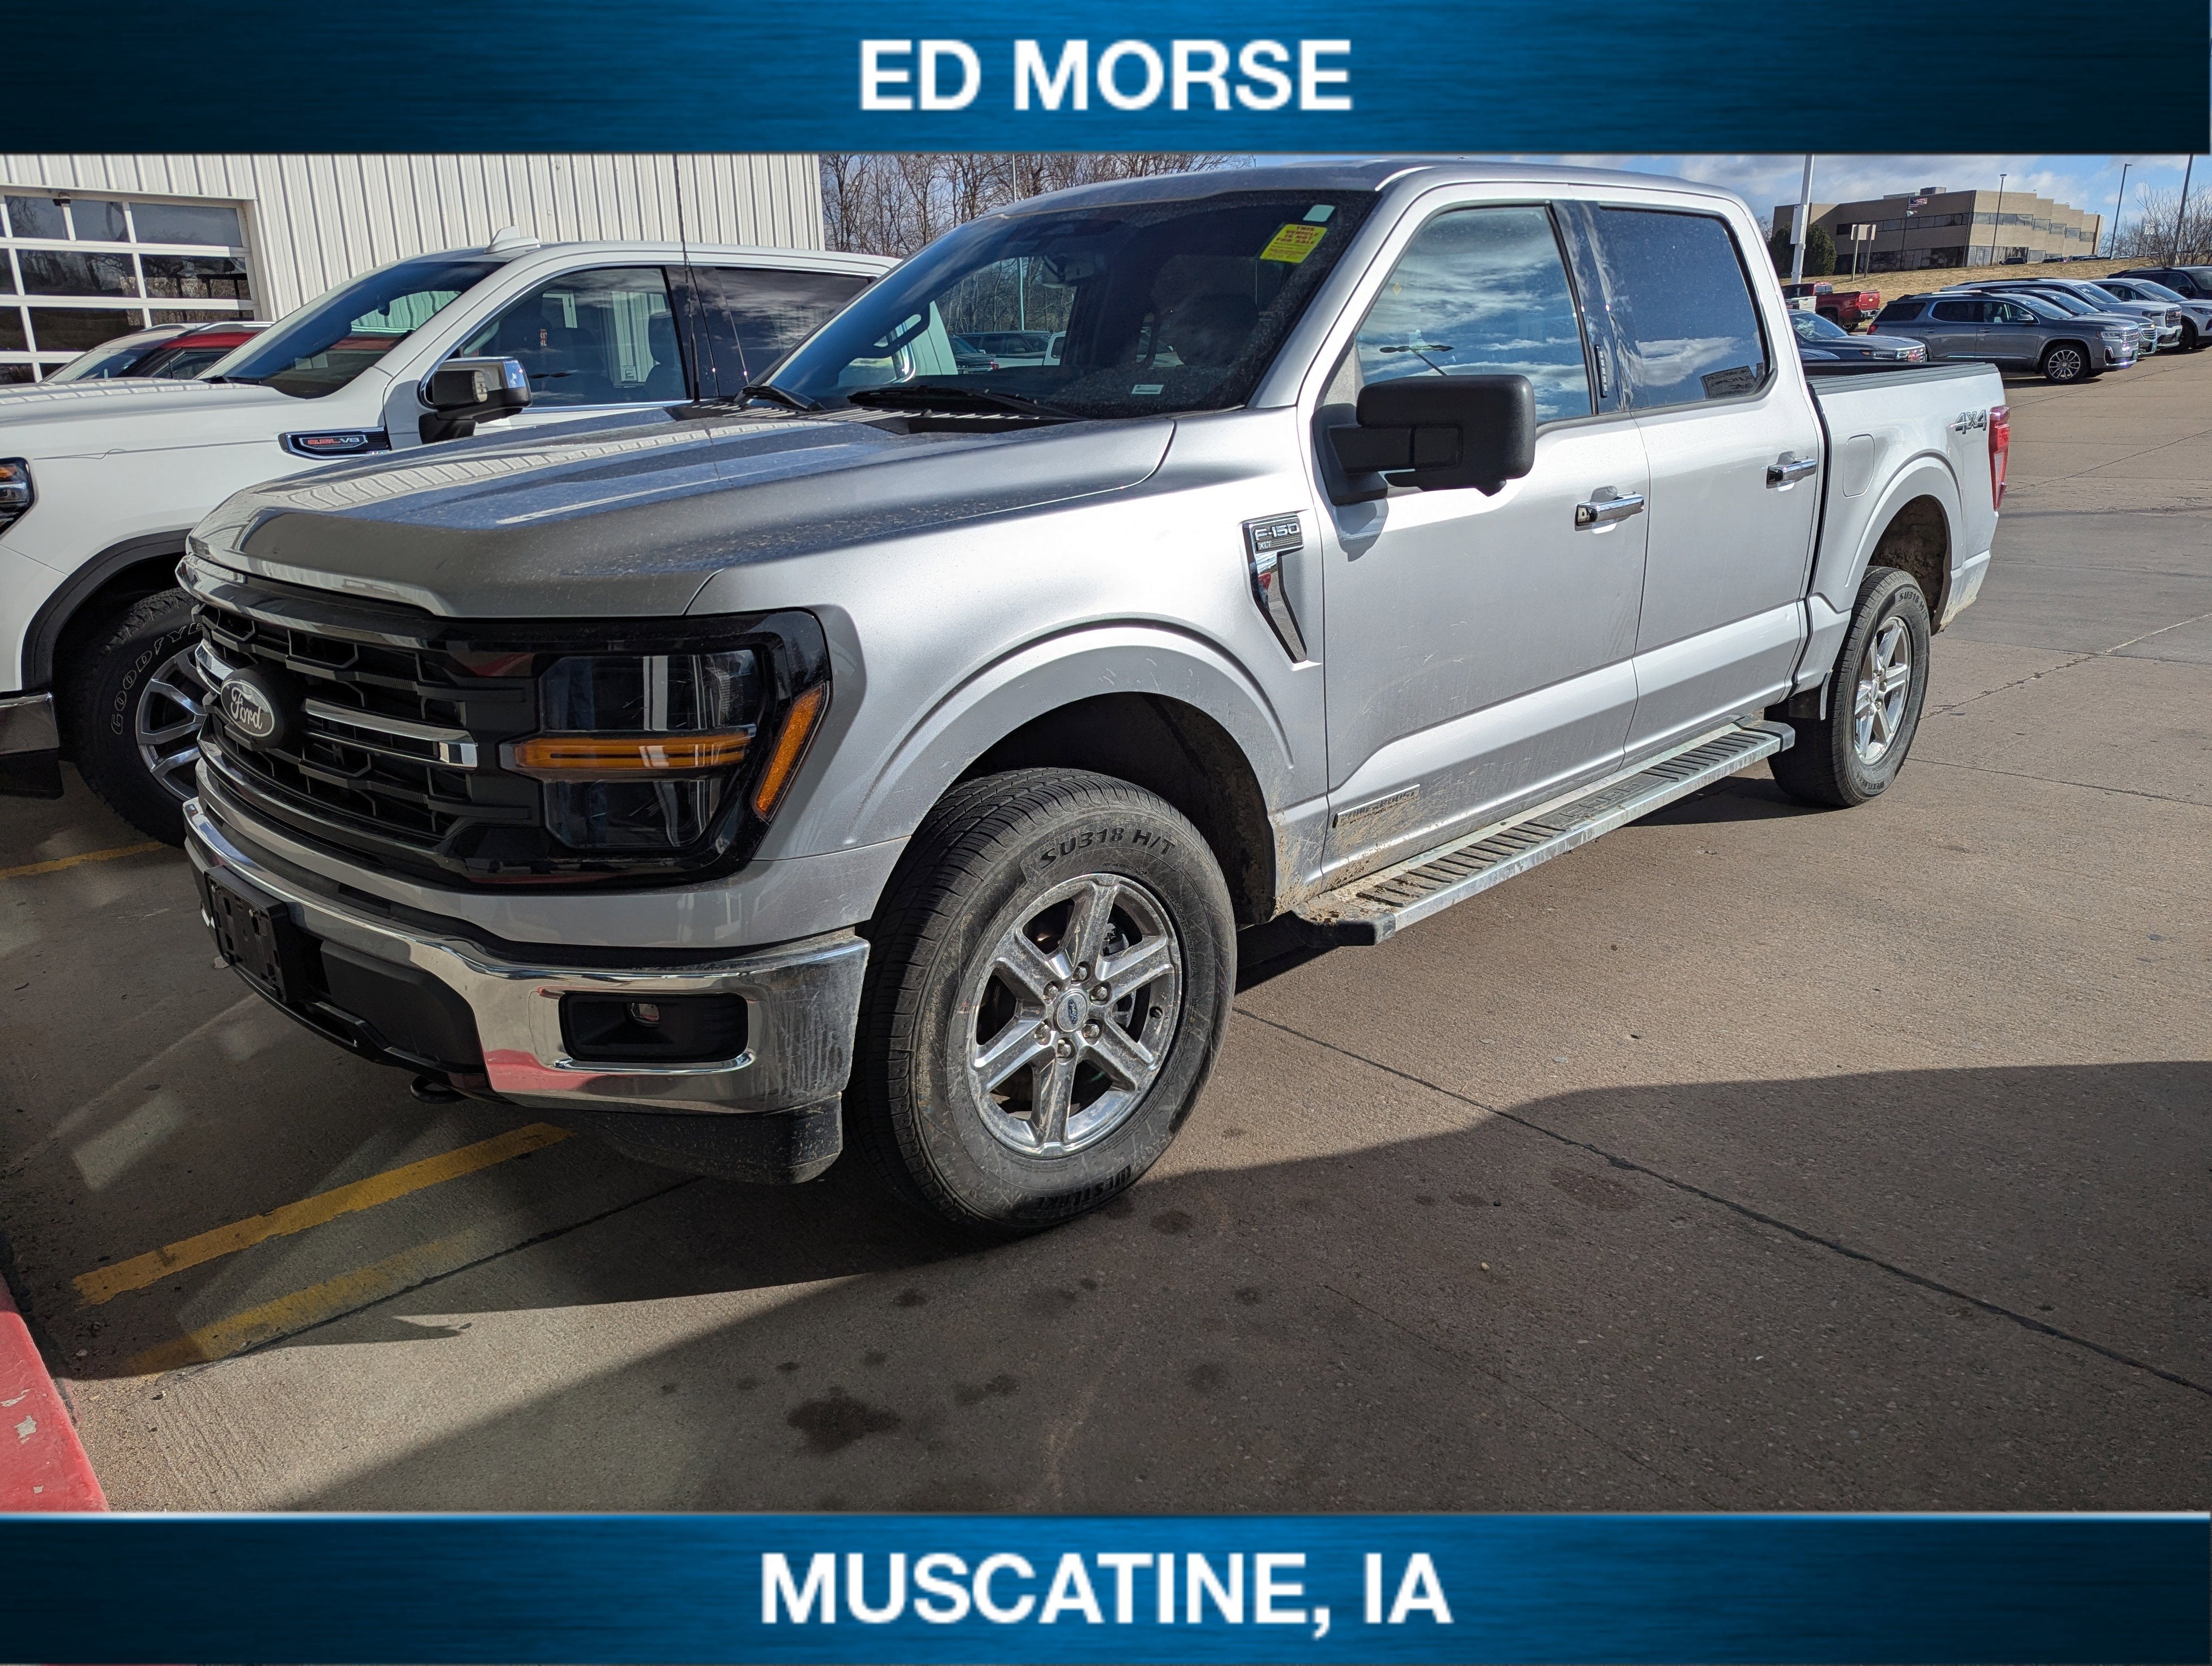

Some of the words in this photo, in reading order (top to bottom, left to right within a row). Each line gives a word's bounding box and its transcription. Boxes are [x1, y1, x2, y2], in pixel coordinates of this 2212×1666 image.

[1255, 523, 1300, 541] F-150
[1898, 591, 1920, 603] SU318
[111, 622, 203, 735] GOODYE
[230, 687, 263, 730] Ford
[1040, 827, 1124, 870] SU318
[1131, 829, 1175, 856] H/T
